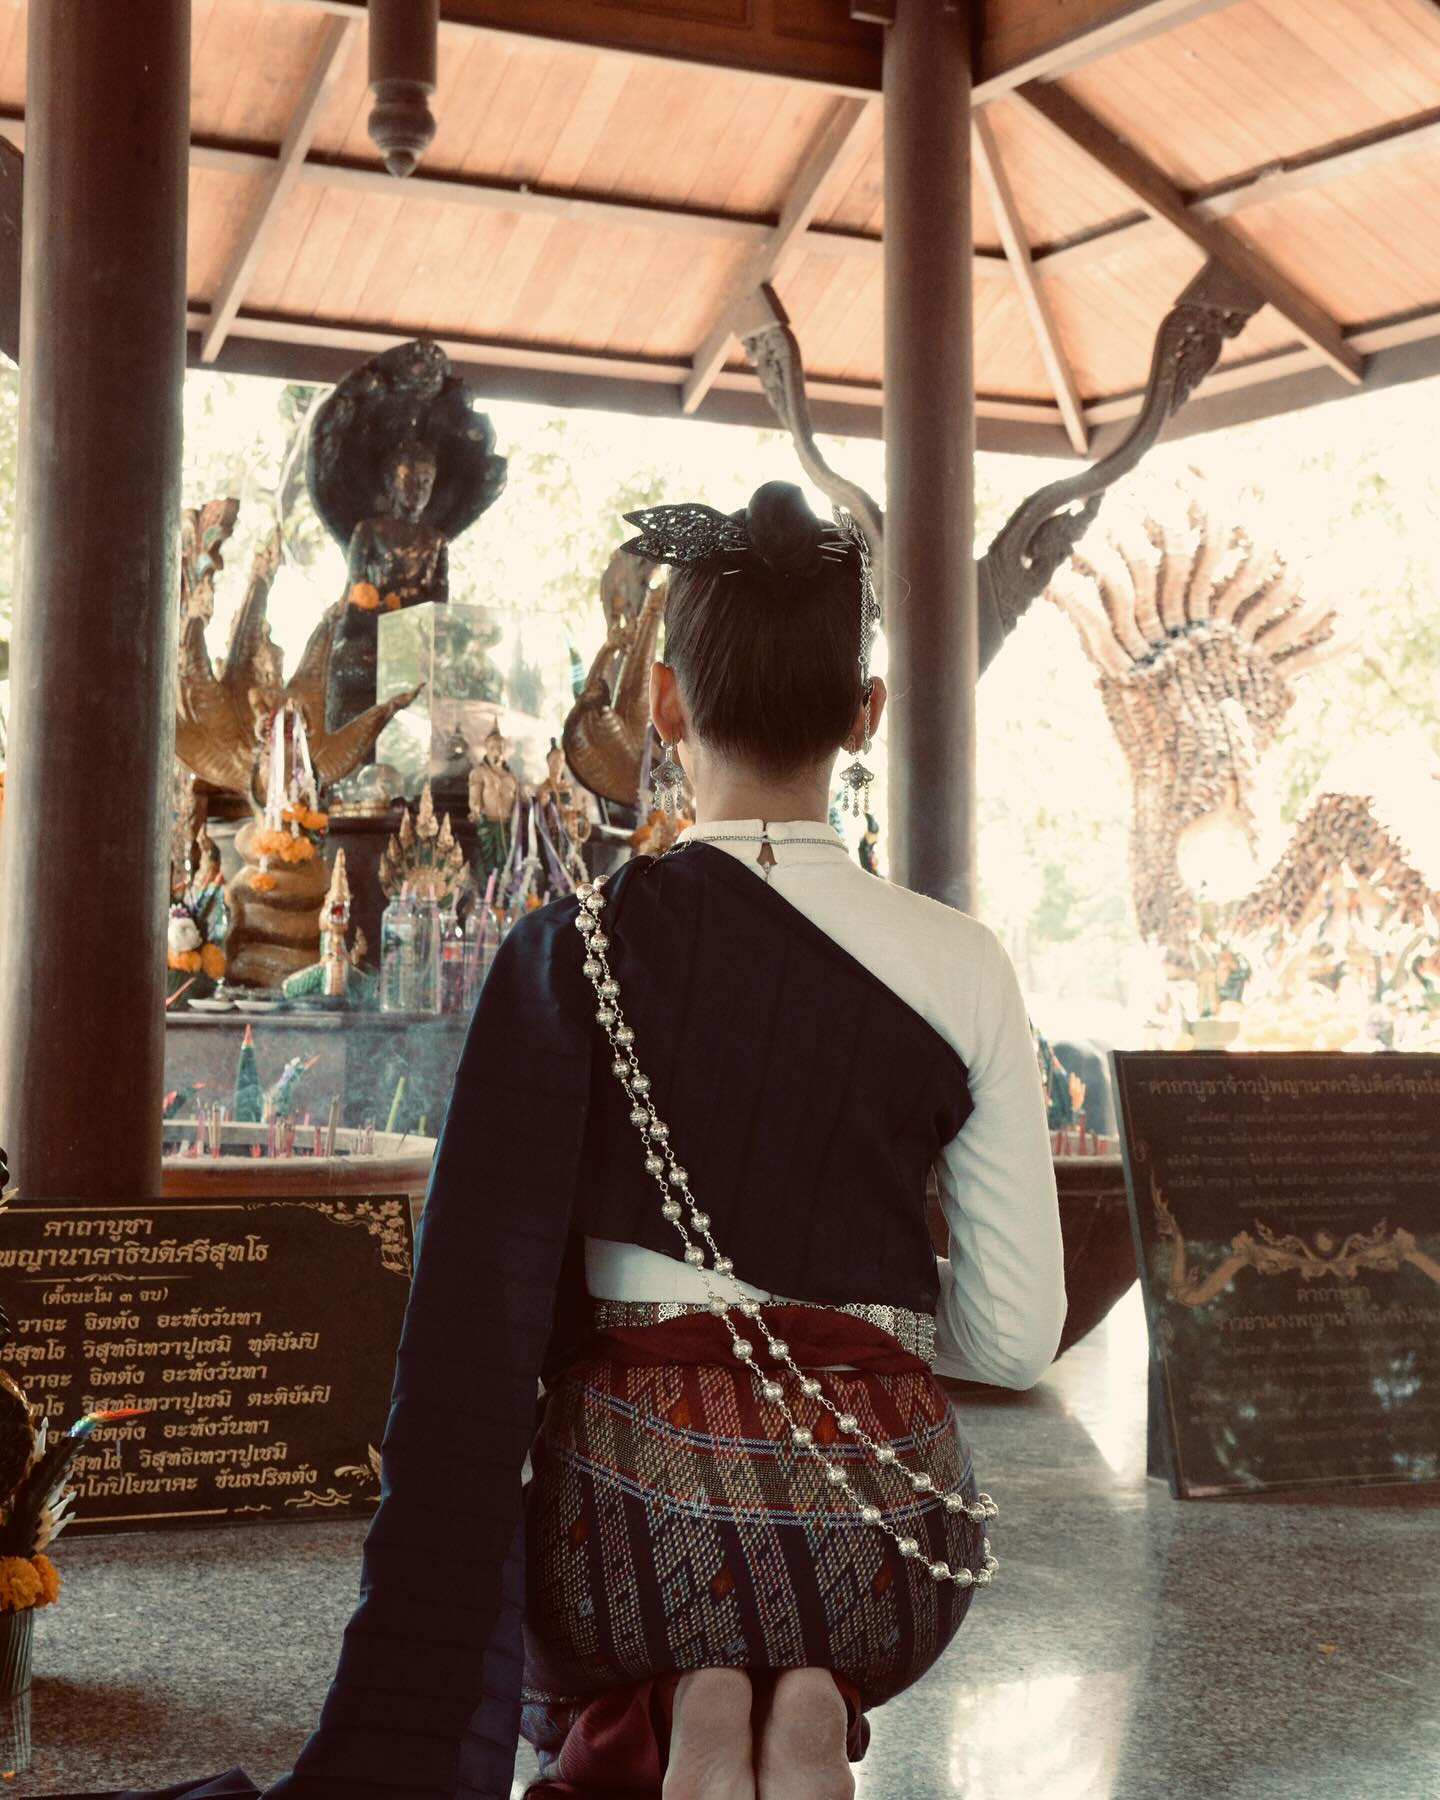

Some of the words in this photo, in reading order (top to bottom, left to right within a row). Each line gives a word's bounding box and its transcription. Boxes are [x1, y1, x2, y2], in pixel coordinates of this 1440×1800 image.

[43, 1218, 154, 1241] คาถาบูชา
[17, 1318, 68, 1334] วาจะ
[21, 1372, 74, 1390] วาจะ
